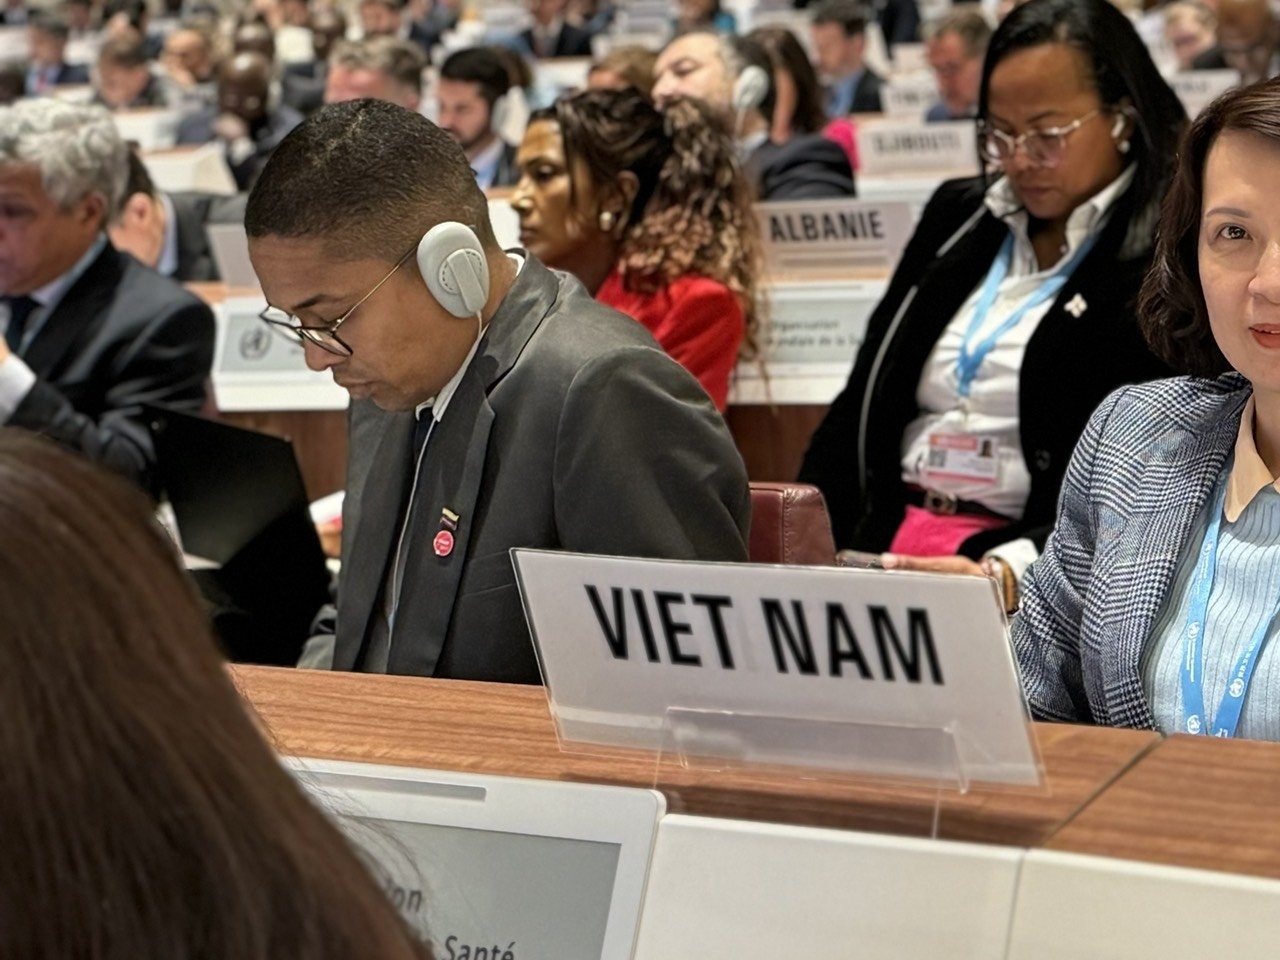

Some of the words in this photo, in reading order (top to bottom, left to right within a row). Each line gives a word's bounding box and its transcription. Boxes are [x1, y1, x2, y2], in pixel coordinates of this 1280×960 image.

[769, 210, 885, 242] ALBANIE
[584, 584, 735, 670] VIET
[760, 598, 945, 686] NAM
[444, 934, 517, 960] Santé
